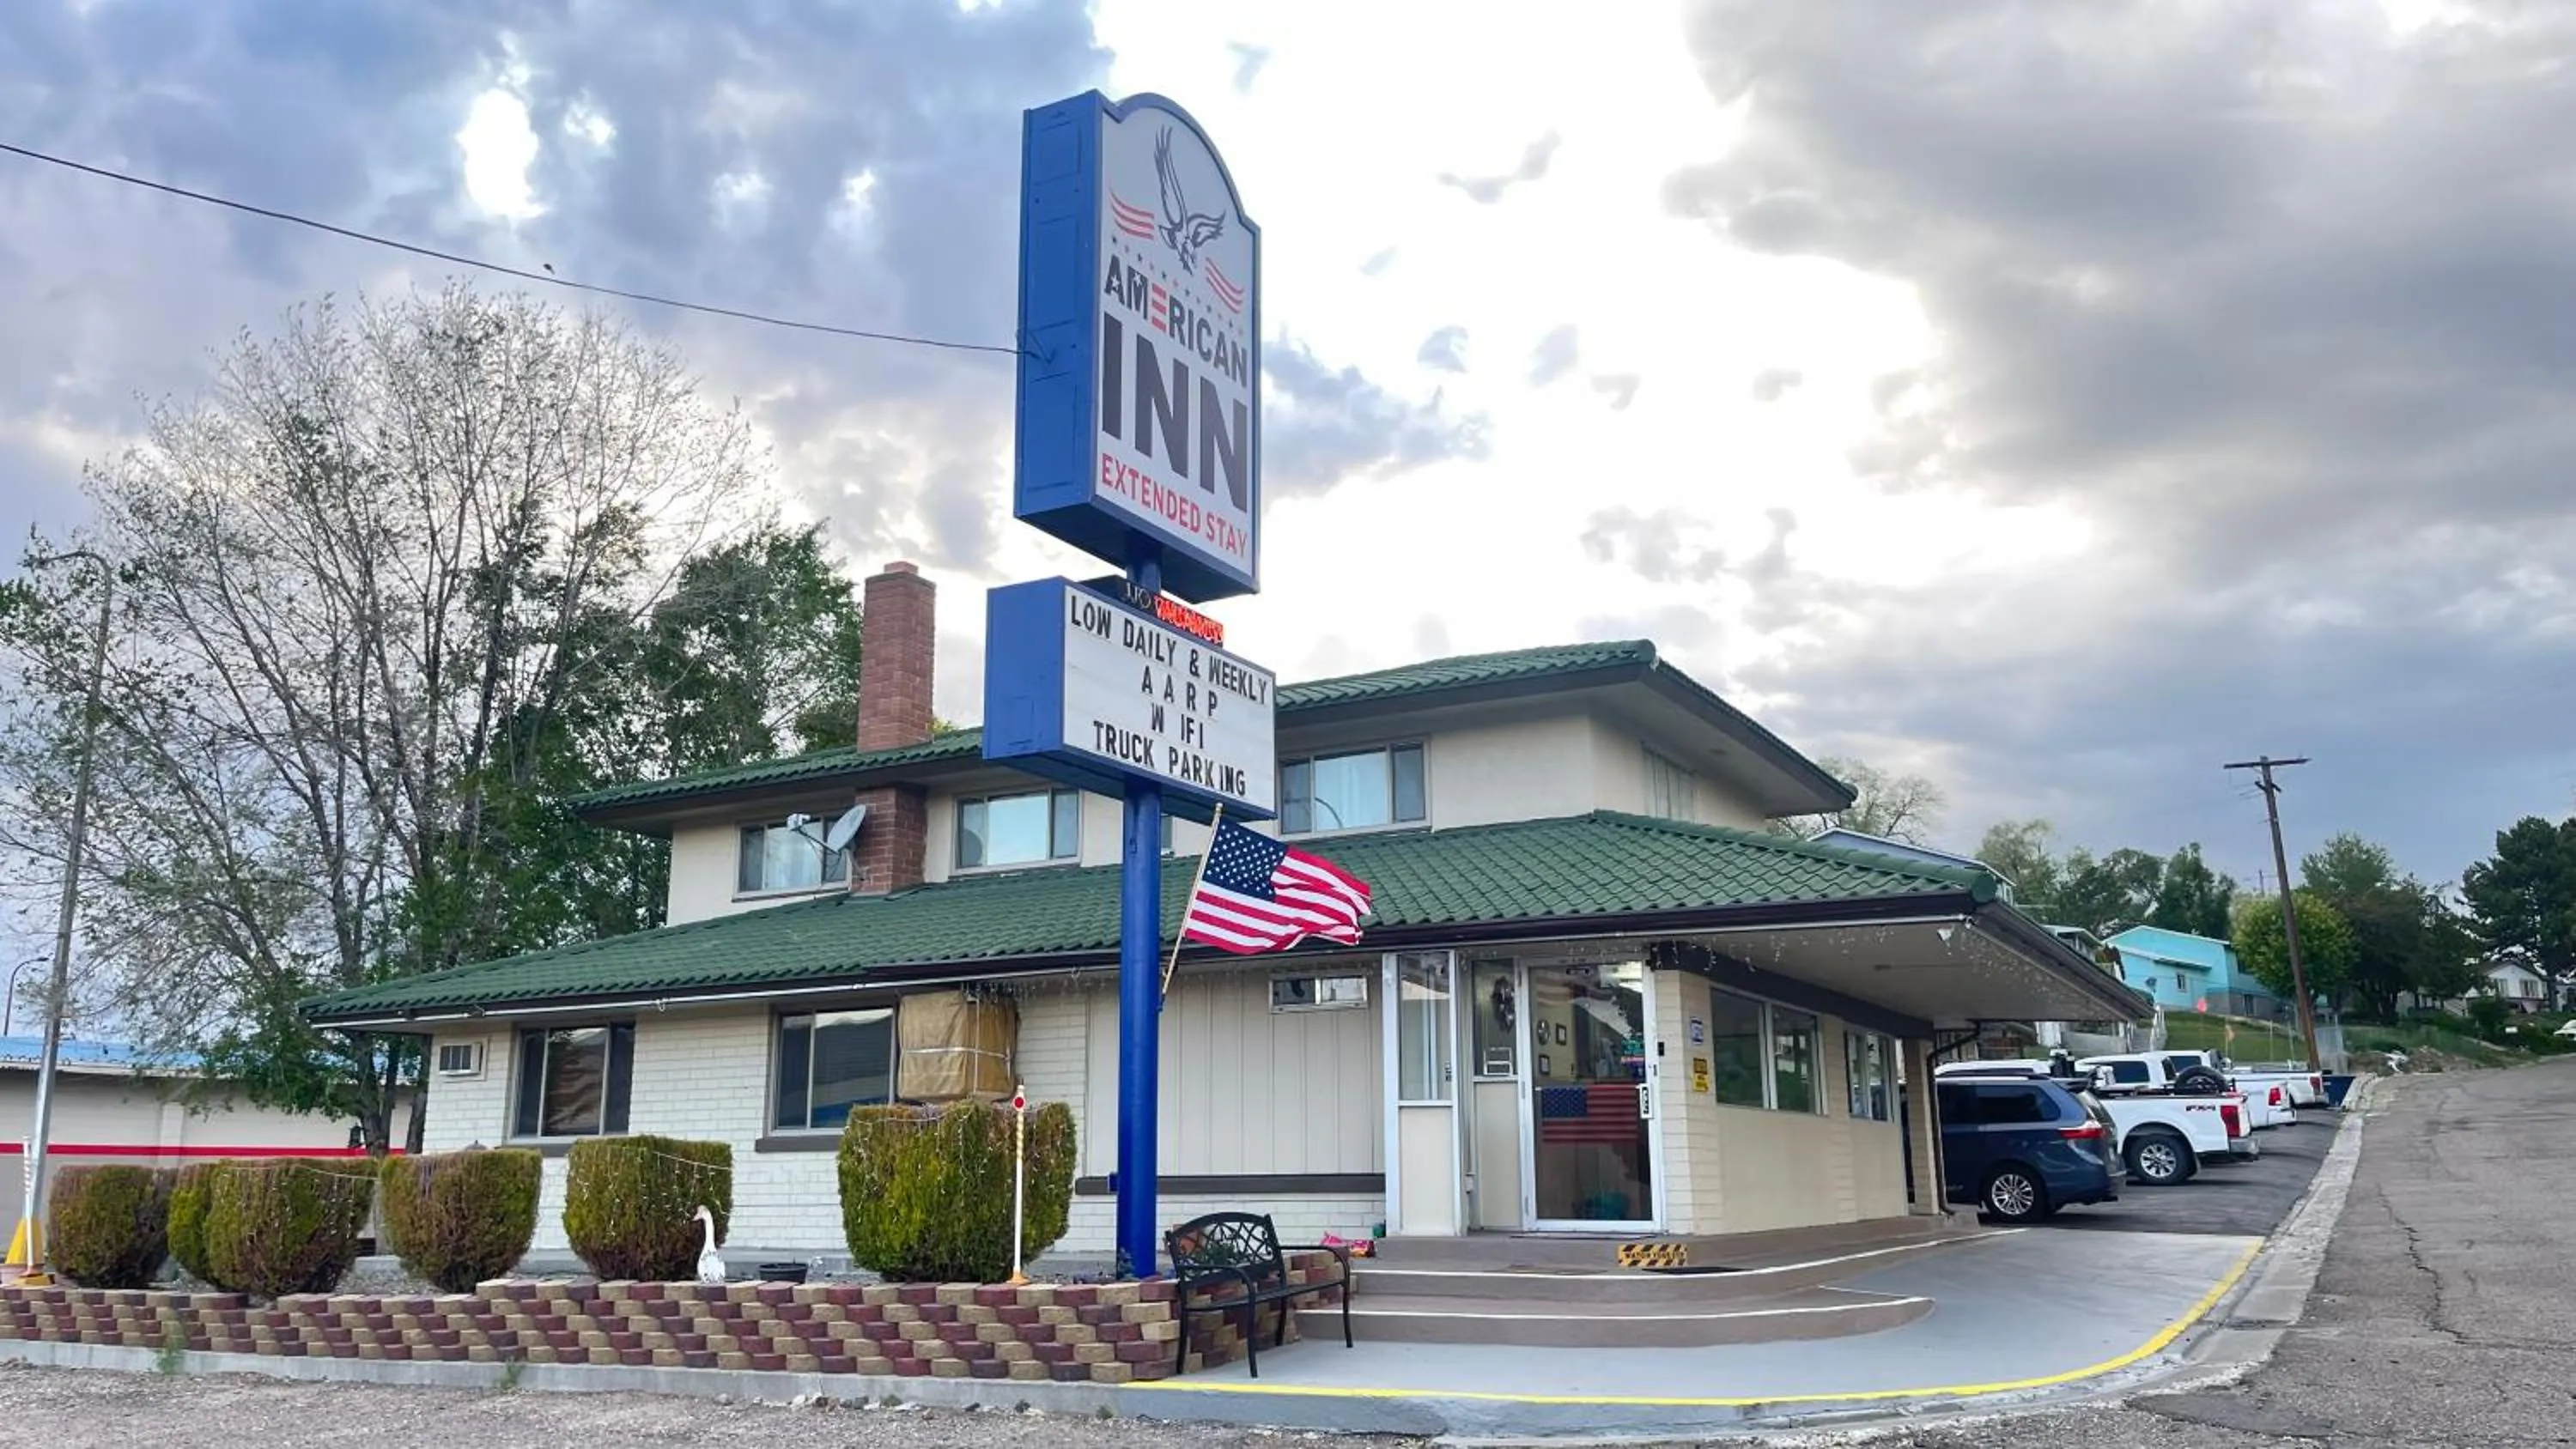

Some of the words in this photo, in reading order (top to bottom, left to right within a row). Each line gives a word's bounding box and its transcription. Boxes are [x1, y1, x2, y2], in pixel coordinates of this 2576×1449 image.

[1104, 254, 1248, 389] AMERICAN
[1103, 312, 1248, 513] INN
[1102, 452, 1201, 534] EXTENDED
[1206, 512, 1248, 559] STAY
[1072, 595, 1111, 640] LOW
[1123, 617, 1176, 668] DAILY
[1190, 648, 1200, 678] &
[1209, 655, 1267, 705] WEEKLY
[1093, 720, 1154, 769] TRUCK
[1169, 746, 1246, 797] PARKING
